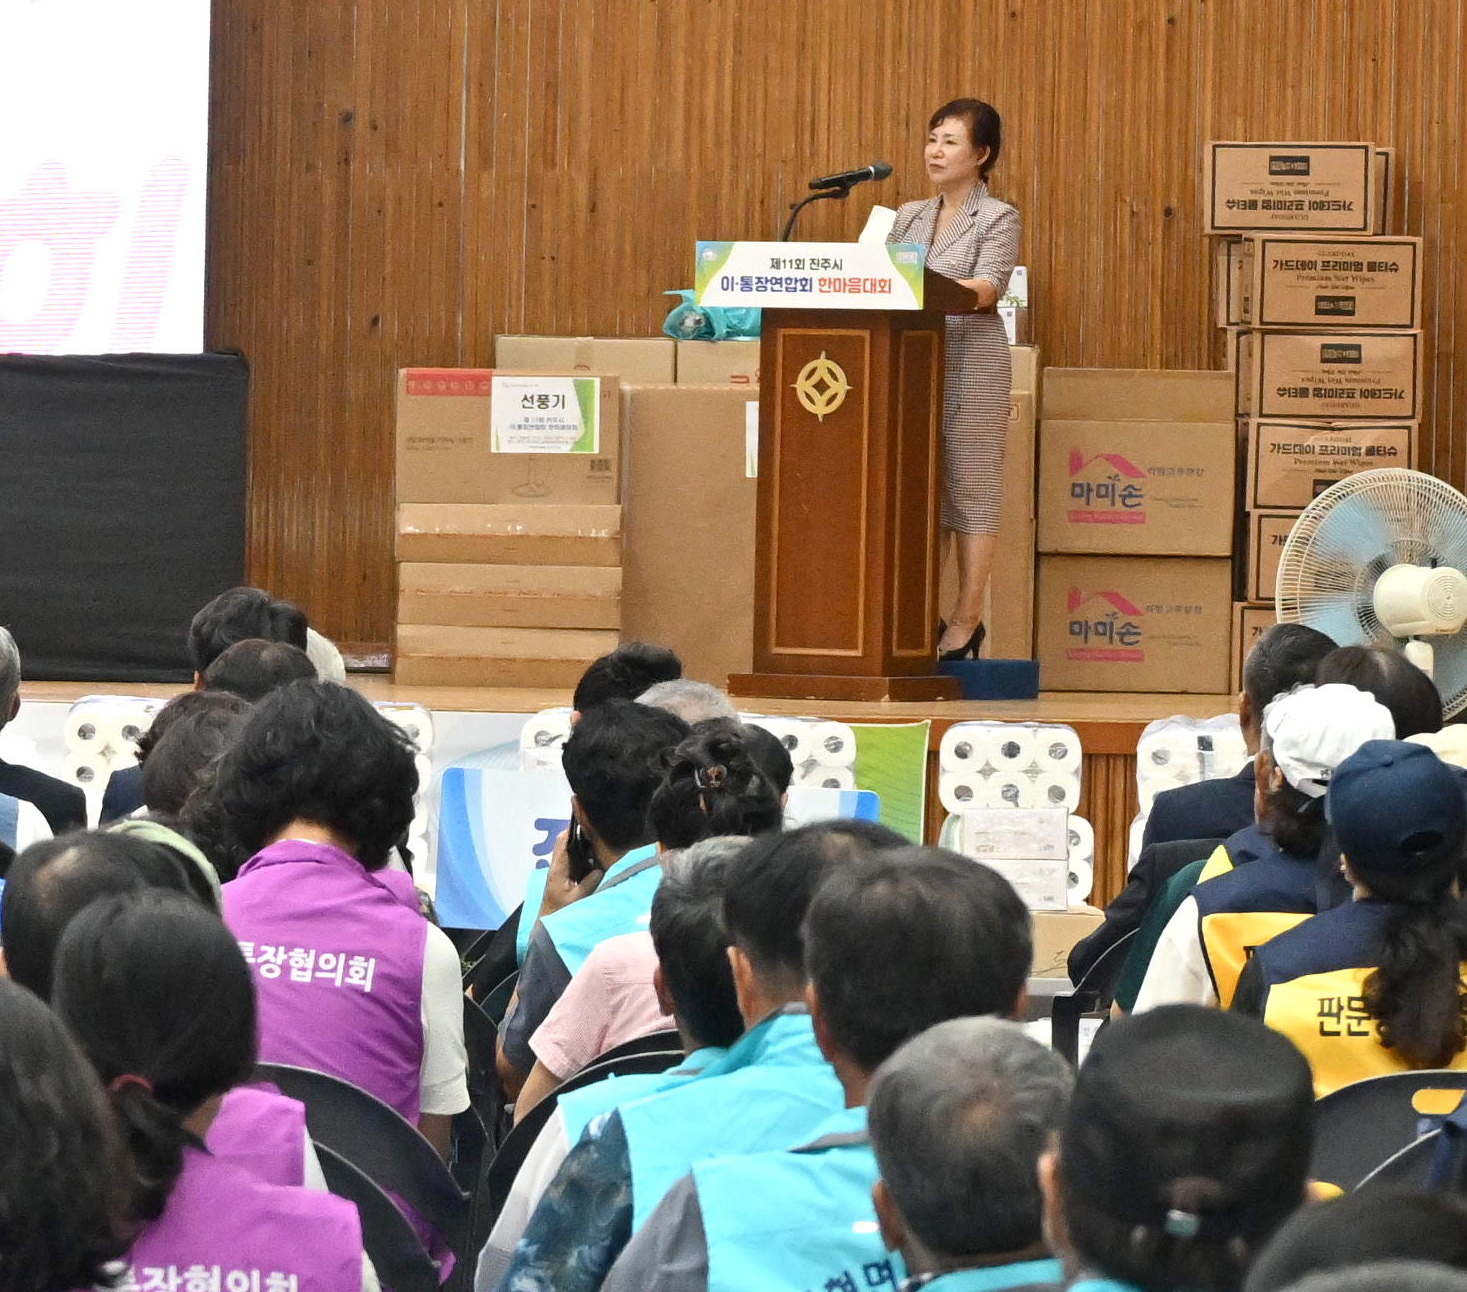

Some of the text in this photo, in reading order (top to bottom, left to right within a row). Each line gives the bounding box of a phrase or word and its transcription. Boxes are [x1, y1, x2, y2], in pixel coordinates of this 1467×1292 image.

[769, 257, 843, 271] 제11회 진주시
[1320, 259, 1364, 273] 프리미엄
[720, 275, 892, 295] 이·통장연합회 한마음대회
[520, 393, 567, 410] 선풍기
[1318, 443, 1363, 457] 프리미엄
[1070, 481, 1145, 508] 마미손
[1068, 619, 1143, 647] 마미손
